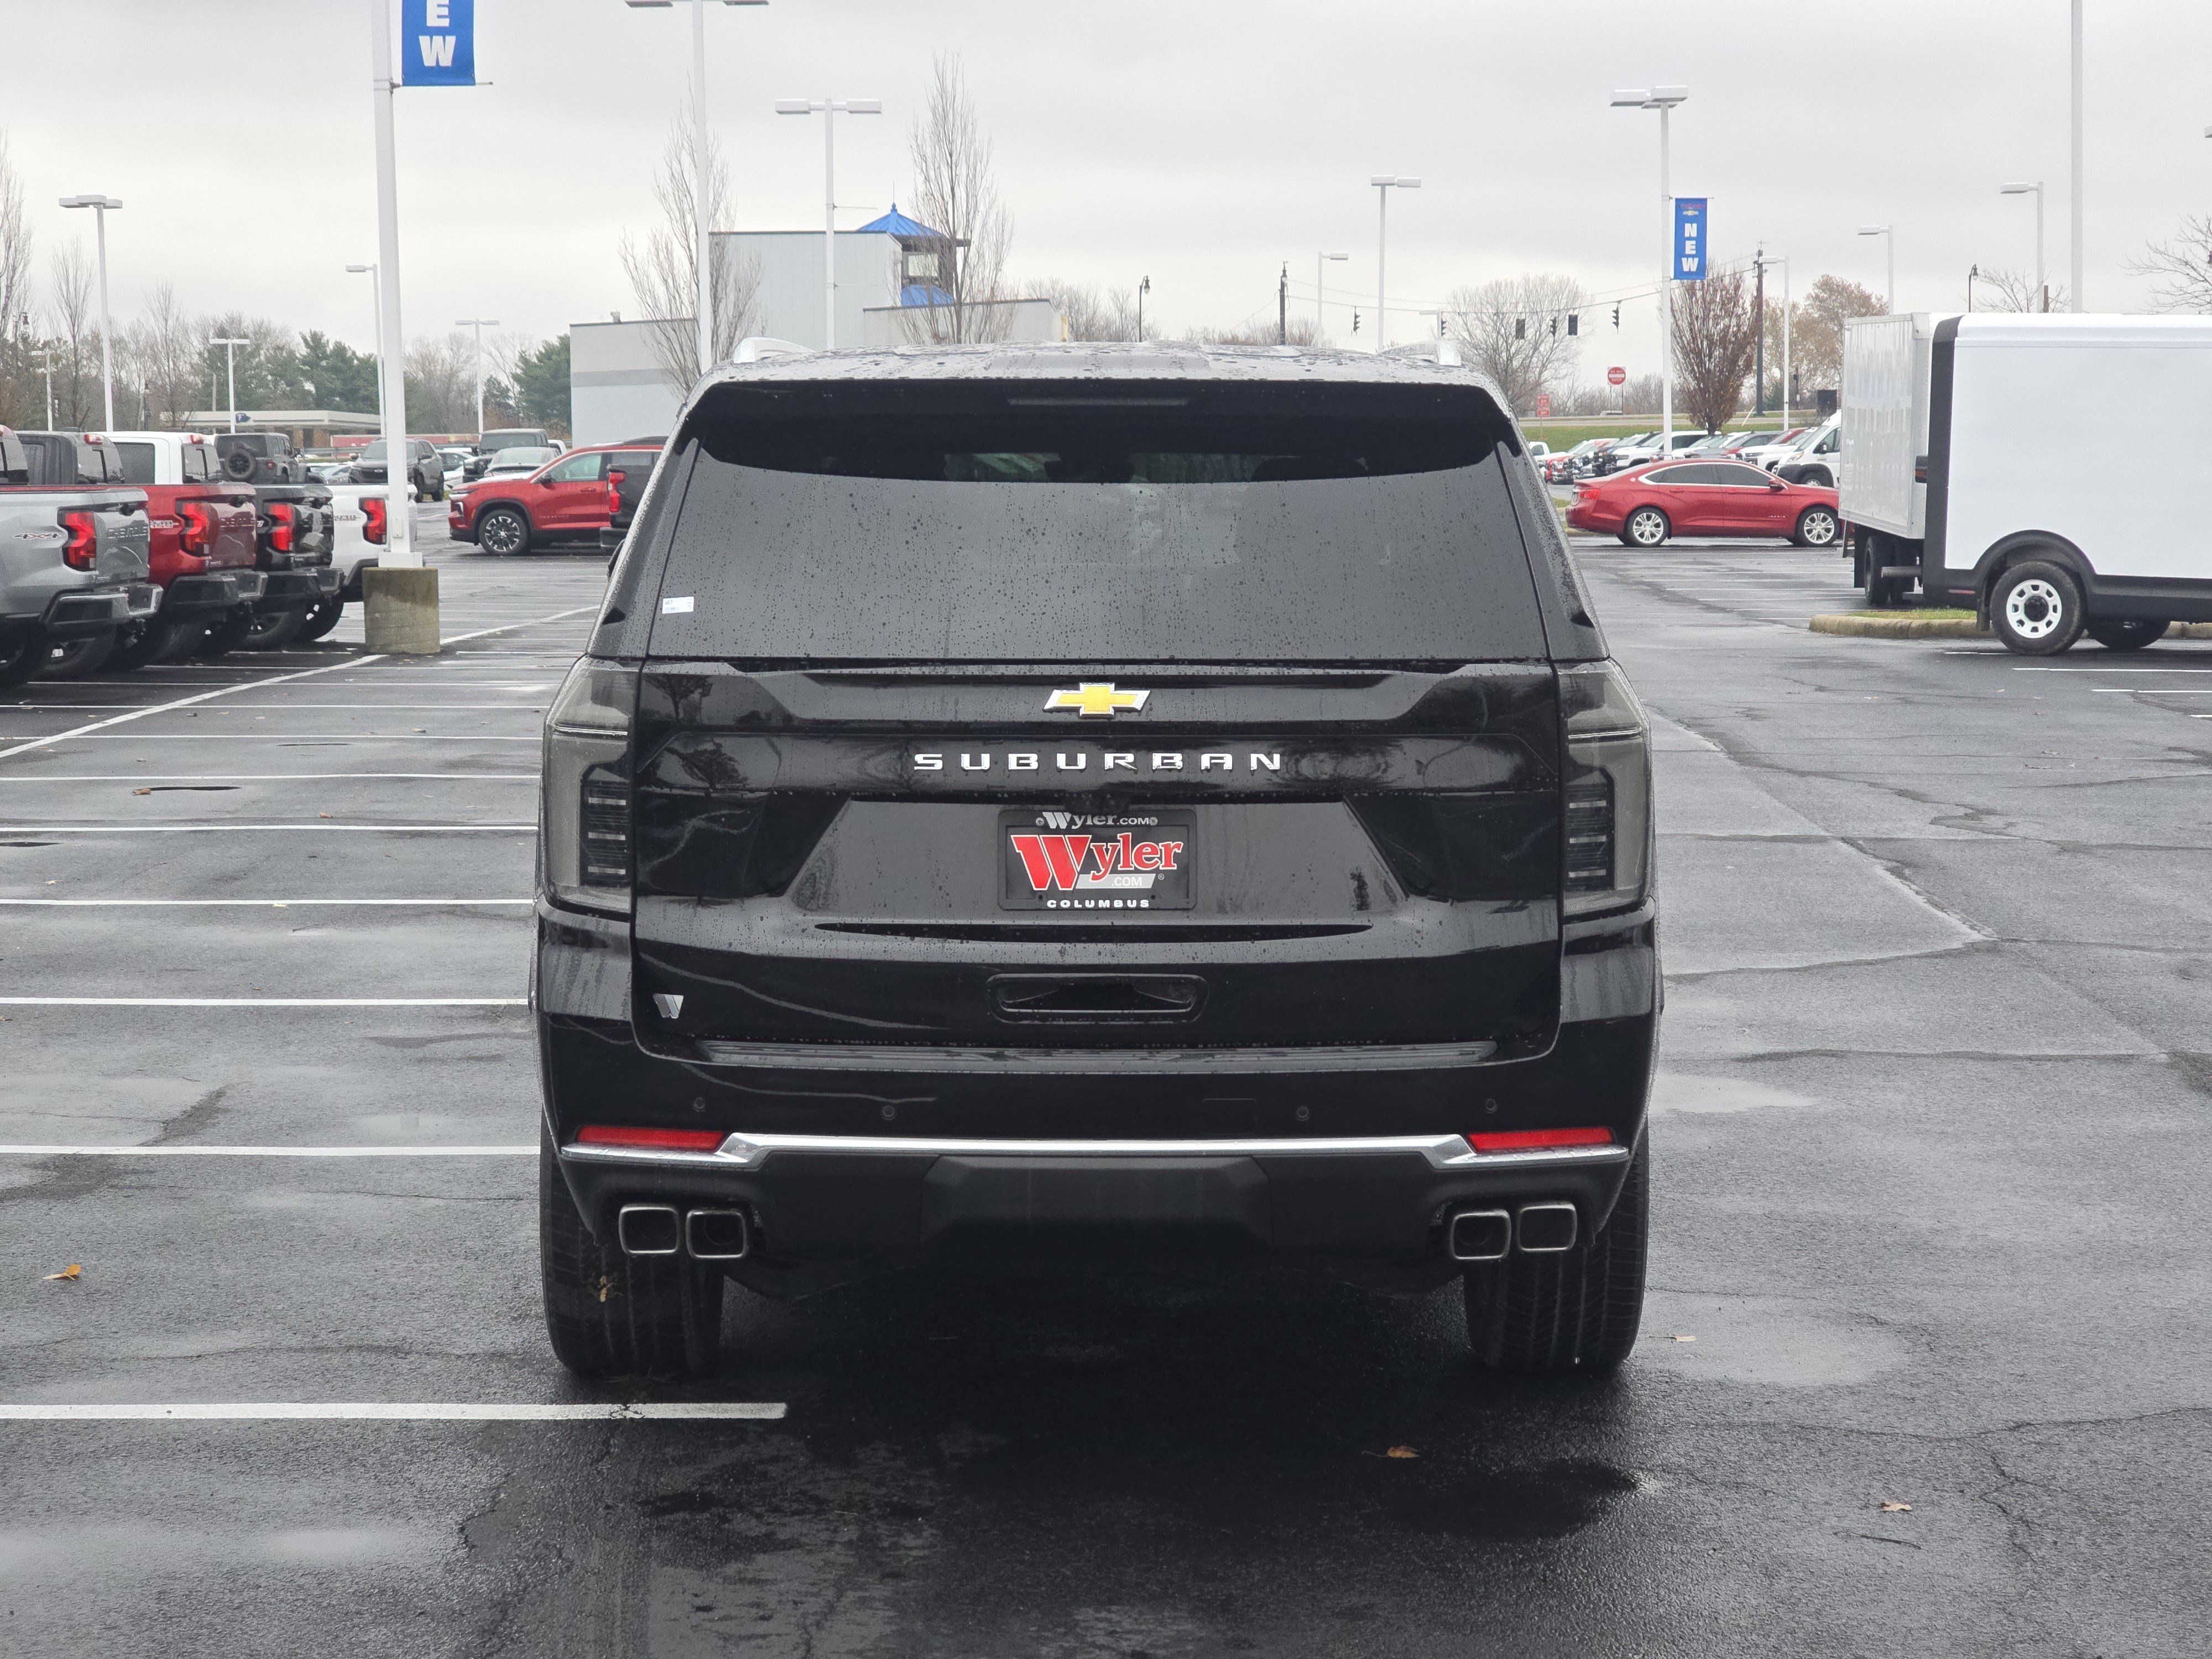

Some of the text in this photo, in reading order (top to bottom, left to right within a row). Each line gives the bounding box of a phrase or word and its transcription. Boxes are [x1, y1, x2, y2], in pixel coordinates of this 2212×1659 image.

[1682, 223, 1699, 272] NEW
[914, 753, 1281, 770] SUBURBAN
[1010, 832, 1183, 891] Wyler
[1047, 899, 1149, 908] COLUMBUS
